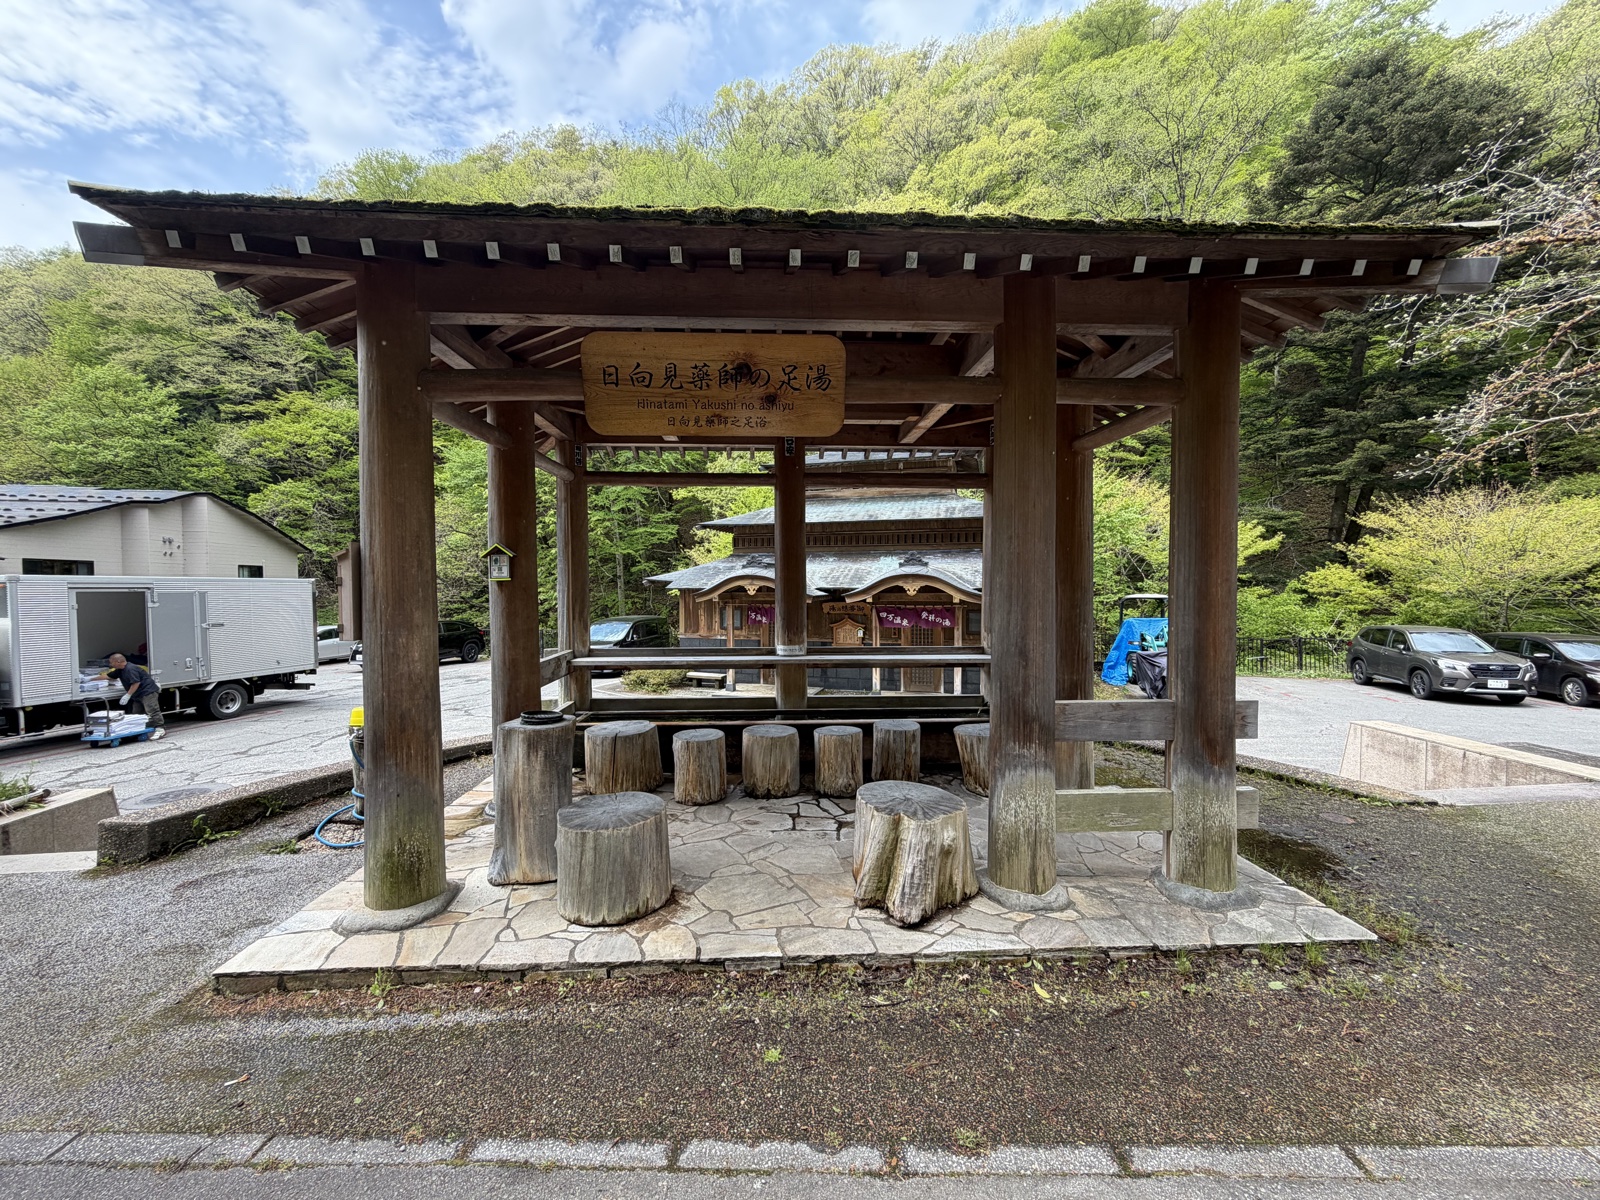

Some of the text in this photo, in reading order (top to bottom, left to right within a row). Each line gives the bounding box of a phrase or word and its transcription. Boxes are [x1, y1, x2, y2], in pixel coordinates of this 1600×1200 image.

[602, 362, 833, 392] 日向見薬師の足湯
[637, 399, 795, 412] Hinatami Yakushi no ashiyu
[879, 611, 910, 627] 四万温泉
